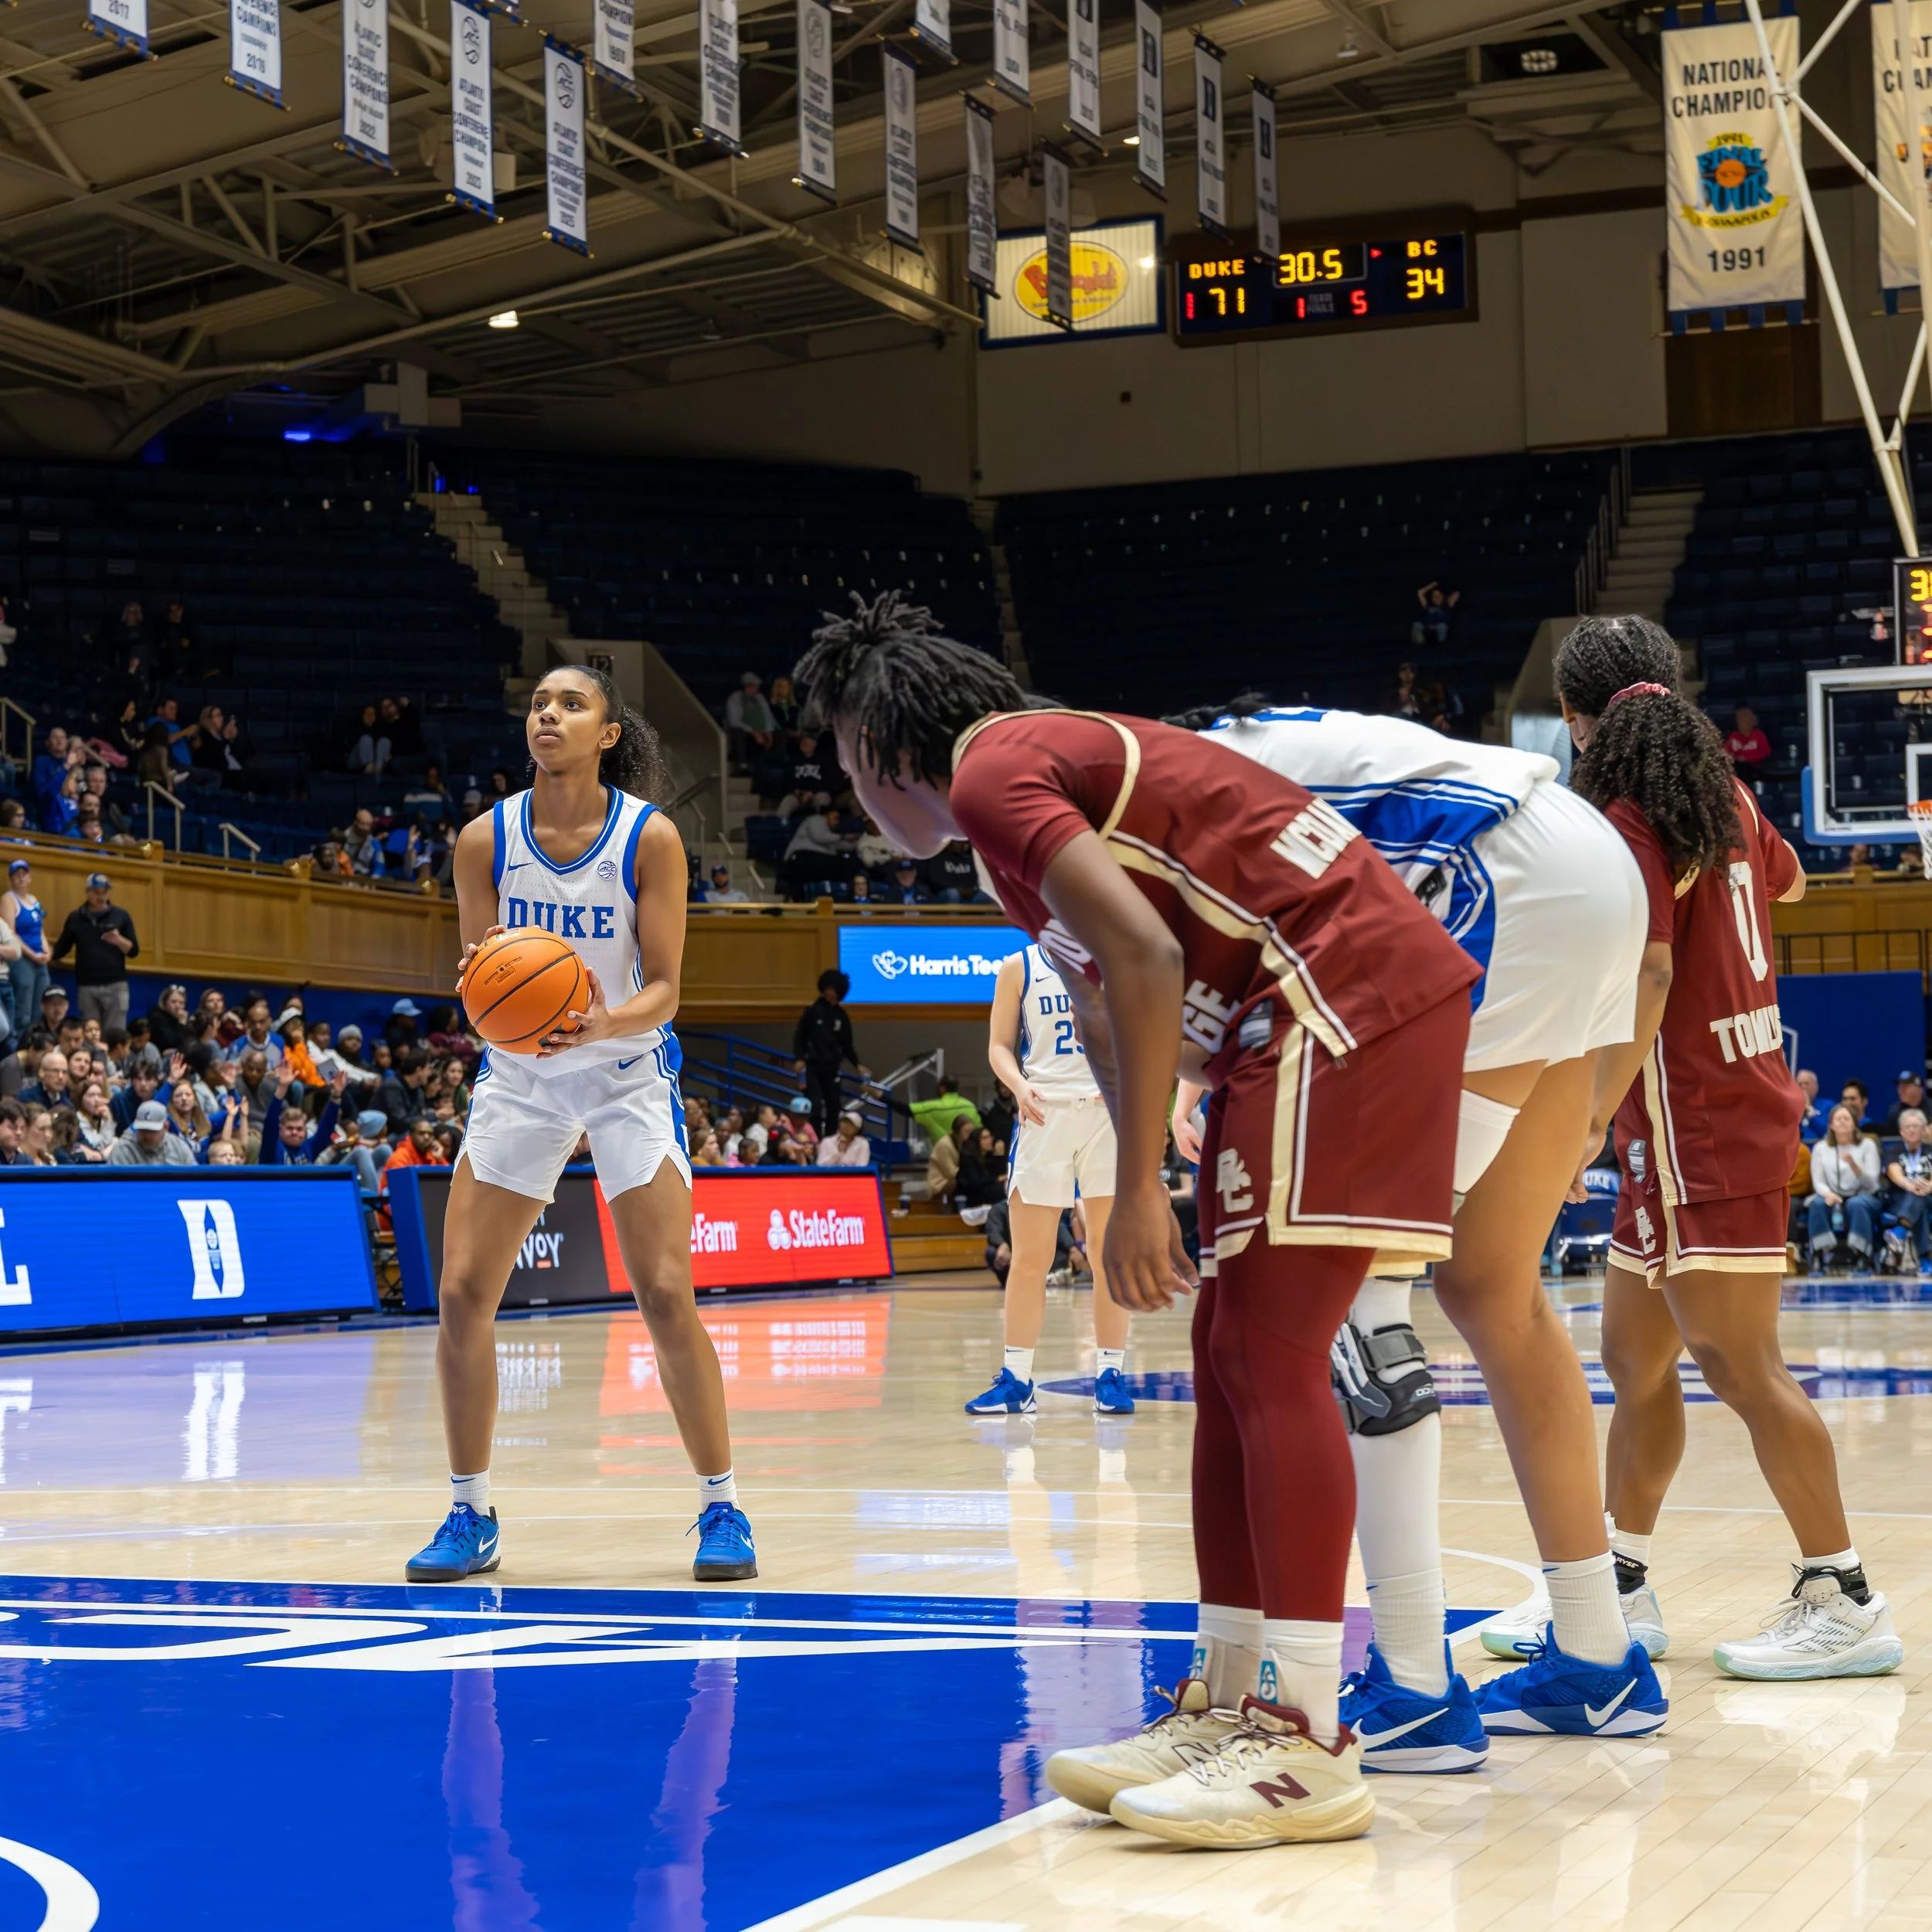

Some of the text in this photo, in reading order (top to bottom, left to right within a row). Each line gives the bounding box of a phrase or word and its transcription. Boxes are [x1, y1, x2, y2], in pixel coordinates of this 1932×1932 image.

[1406, 240, 1438, 257] BC
[1706, 245, 1766, 273] 1991
[1189, 259, 1245, 279] DUKE
[1278, 248, 1343, 284] 30.5
[1406, 267, 1445, 299] 34
[1209, 287, 1246, 315] 71
[1350, 289, 1368, 315] 5
[1910, 569, 1932, 601] 3
[507, 897, 615, 939] DUKE
[1727, 861, 1769, 981] 0
[910, 954, 1008, 976] Harris Tee
[1039, 995, 1070, 1016] DU
[1583, 1172, 1611, 1190] UKE
[177, 1199, 245, 1300] D
